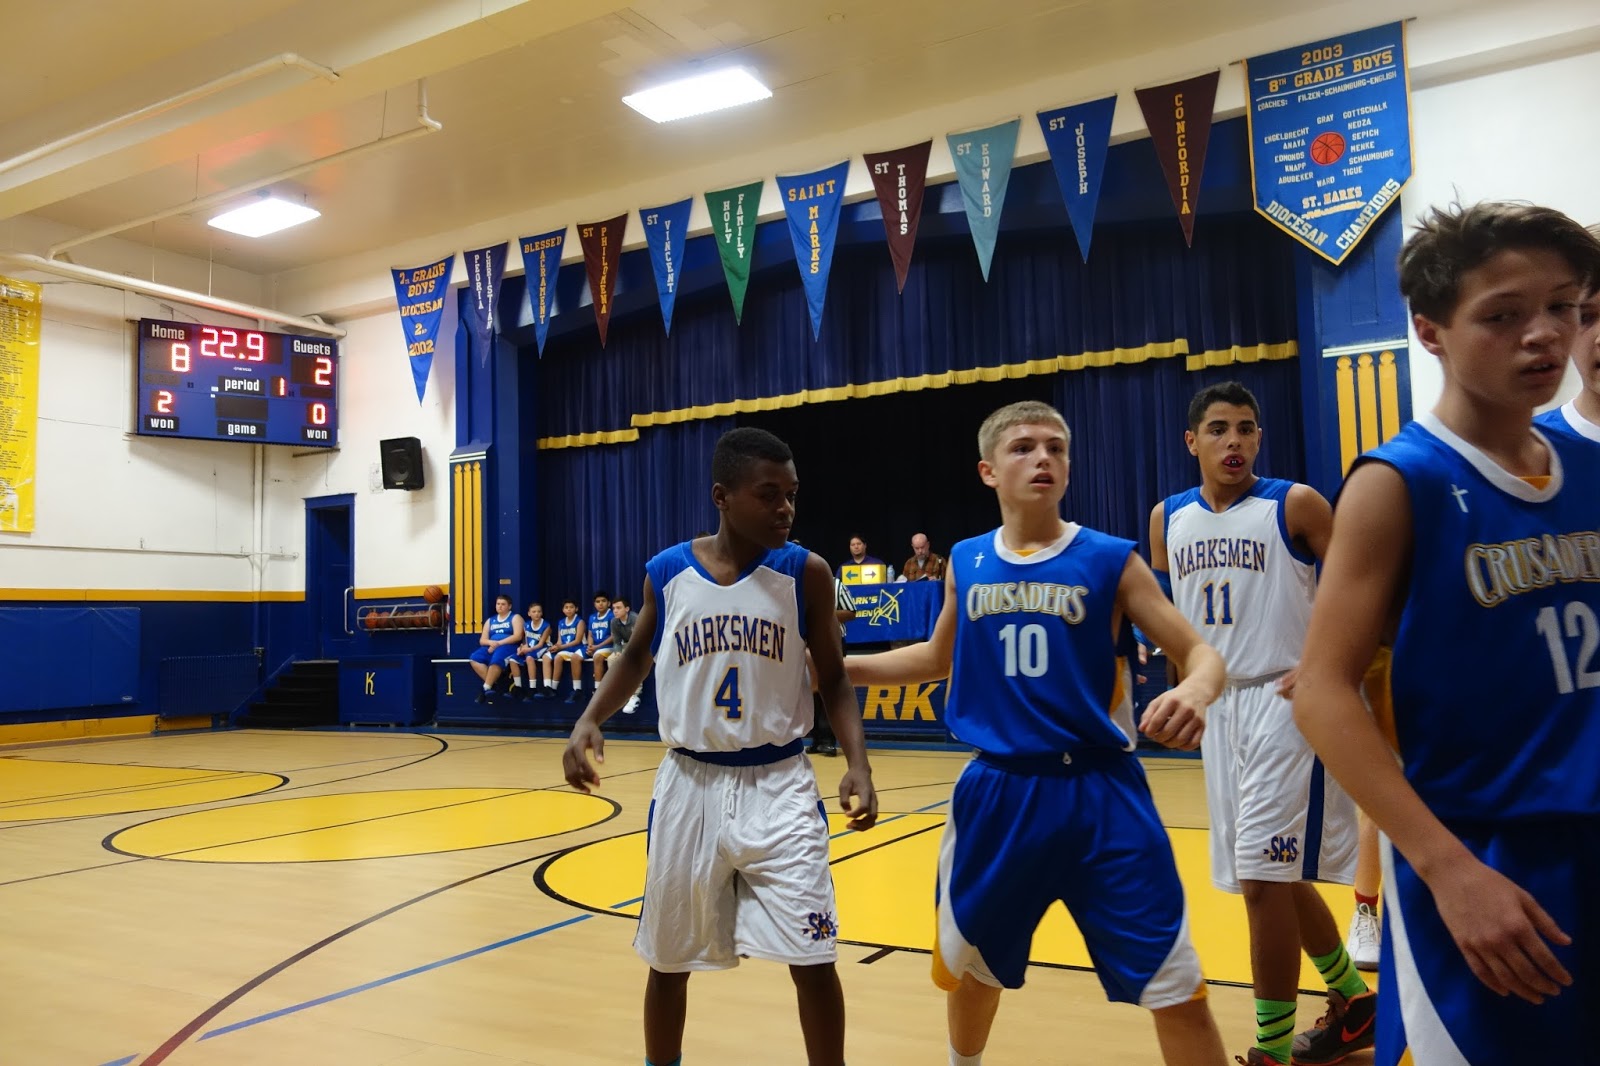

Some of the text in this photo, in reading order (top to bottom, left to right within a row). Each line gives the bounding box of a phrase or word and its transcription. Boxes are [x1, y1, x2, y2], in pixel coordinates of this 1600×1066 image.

[1301, 43, 1343, 66] 2003
[1268, 50, 1393, 93] 8TH GRADE BOYS
[1257, 99, 1288, 112] COACHES:
[1342, 101, 1388, 120] GOTTSCHALK
[1049, 116, 1066, 131] ST
[1316, 113, 1334, 125] GRAY
[1347, 118, 1372, 131] NEDZA
[1264, 126, 1310, 145] ENGELBRECHT
[1282, 138, 1306, 150] ANAYA
[1351, 128, 1379, 141] SEPICH
[956, 142, 972, 156] ST
[1075, 122, 1088, 195] JOSEPH
[1174, 94, 1191, 215] CONCORDIA
[1274, 151, 1305, 164] EDMONDS
[1348, 149, 1394, 166] SCHAUMBURG
[1350, 141, 1375, 153] MENKE
[874, 162, 890, 175] ST
[1284, 162, 1307, 173] KNAPP
[1342, 165, 1363, 177] TIGUE
[788, 180, 836, 202] SAINT
[981, 143, 991, 218] EDWARD
[1316, 176, 1335, 188] WARD
[897, 164, 908, 235] THOMAS
[1302, 185, 1363, 209] ST. MARKS
[647, 214, 659, 226] ST
[723, 200, 732, 244] HOLY
[1265, 199, 1329, 247] DIOCESAN
[1335, 177, 1401, 250] CHAMPIONS
[583, 227, 594, 238] ST
[736, 193, 745, 259] FAMILY
[524, 236, 562, 254] BLESSED
[808, 205, 820, 274] MARKS
[664, 220, 675, 293] VINCENT
[412, 261, 446, 284] GRADE
[600, 226, 609, 314] PHILOMENA
[407, 280, 436, 298] BOYS
[474, 254, 484, 310] PEORIA
[485, 250, 494, 330] CHRISTIAN
[401, 298, 443, 317] DIOCESAN
[151, 324, 185, 341] Home
[200, 327, 264, 362] 22.9
[293, 339, 331, 356] Guests
[408, 340, 434, 357] 2002
[171, 343, 190, 373] 8
[315, 358, 332, 386] 2
[224, 377, 285, 396] period 1
[157, 390, 173, 413] 2
[150, 417, 174, 430] won
[312, 403, 326, 425] 0
[227, 423, 257, 436] game
[306, 429, 328, 440] won
[1174, 537, 1265, 580] MARKSMEN
[966, 581, 1089, 625] CRUSADERS
[1202, 580, 1234, 626] 11
[674, 614, 786, 667] MARKSMEN
[999, 623, 1049, 678] 10
[1535, 600, 1600, 695] 12
[365, 672, 376, 695] K
[445, 672, 453, 695] 1
[713, 665, 743, 722] 4
[1270, 836, 1298, 863] SMS
